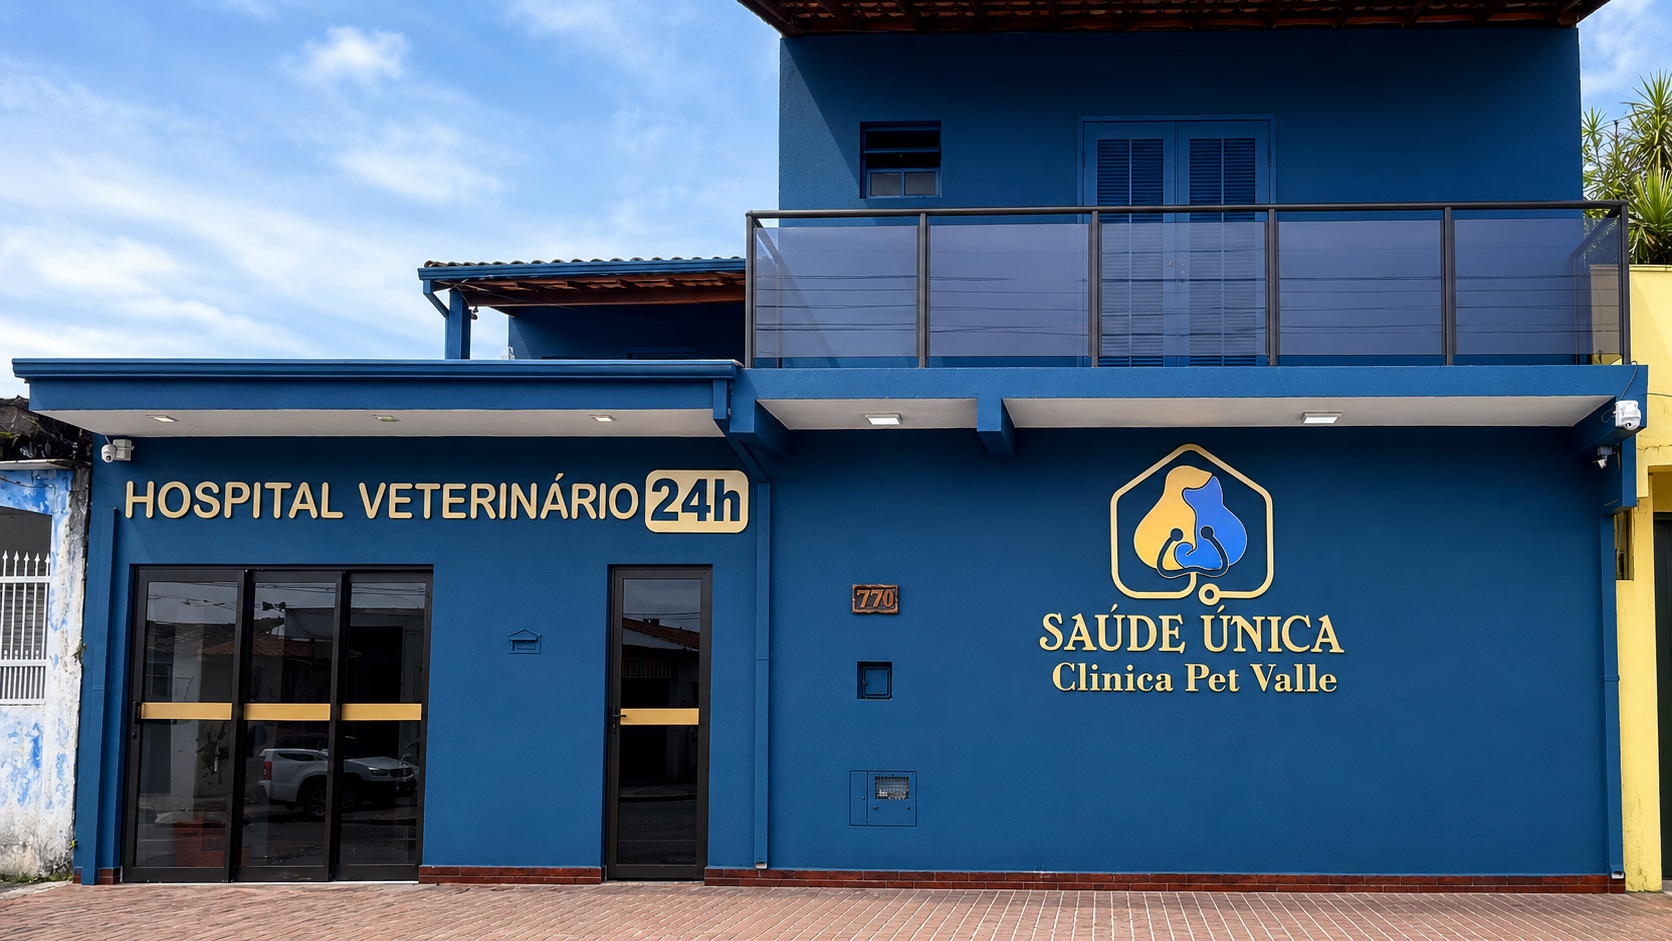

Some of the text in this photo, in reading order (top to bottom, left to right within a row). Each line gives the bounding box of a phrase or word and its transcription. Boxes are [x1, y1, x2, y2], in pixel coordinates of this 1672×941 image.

[125, 472, 740, 521] HOSPITAL VETERINÁRIO 24h
[856, 589, 894, 608] 770
[1039, 604, 1345, 654] SAÚDE ÚNICA
[1052, 662, 1338, 693] Clinica Pet Valle
